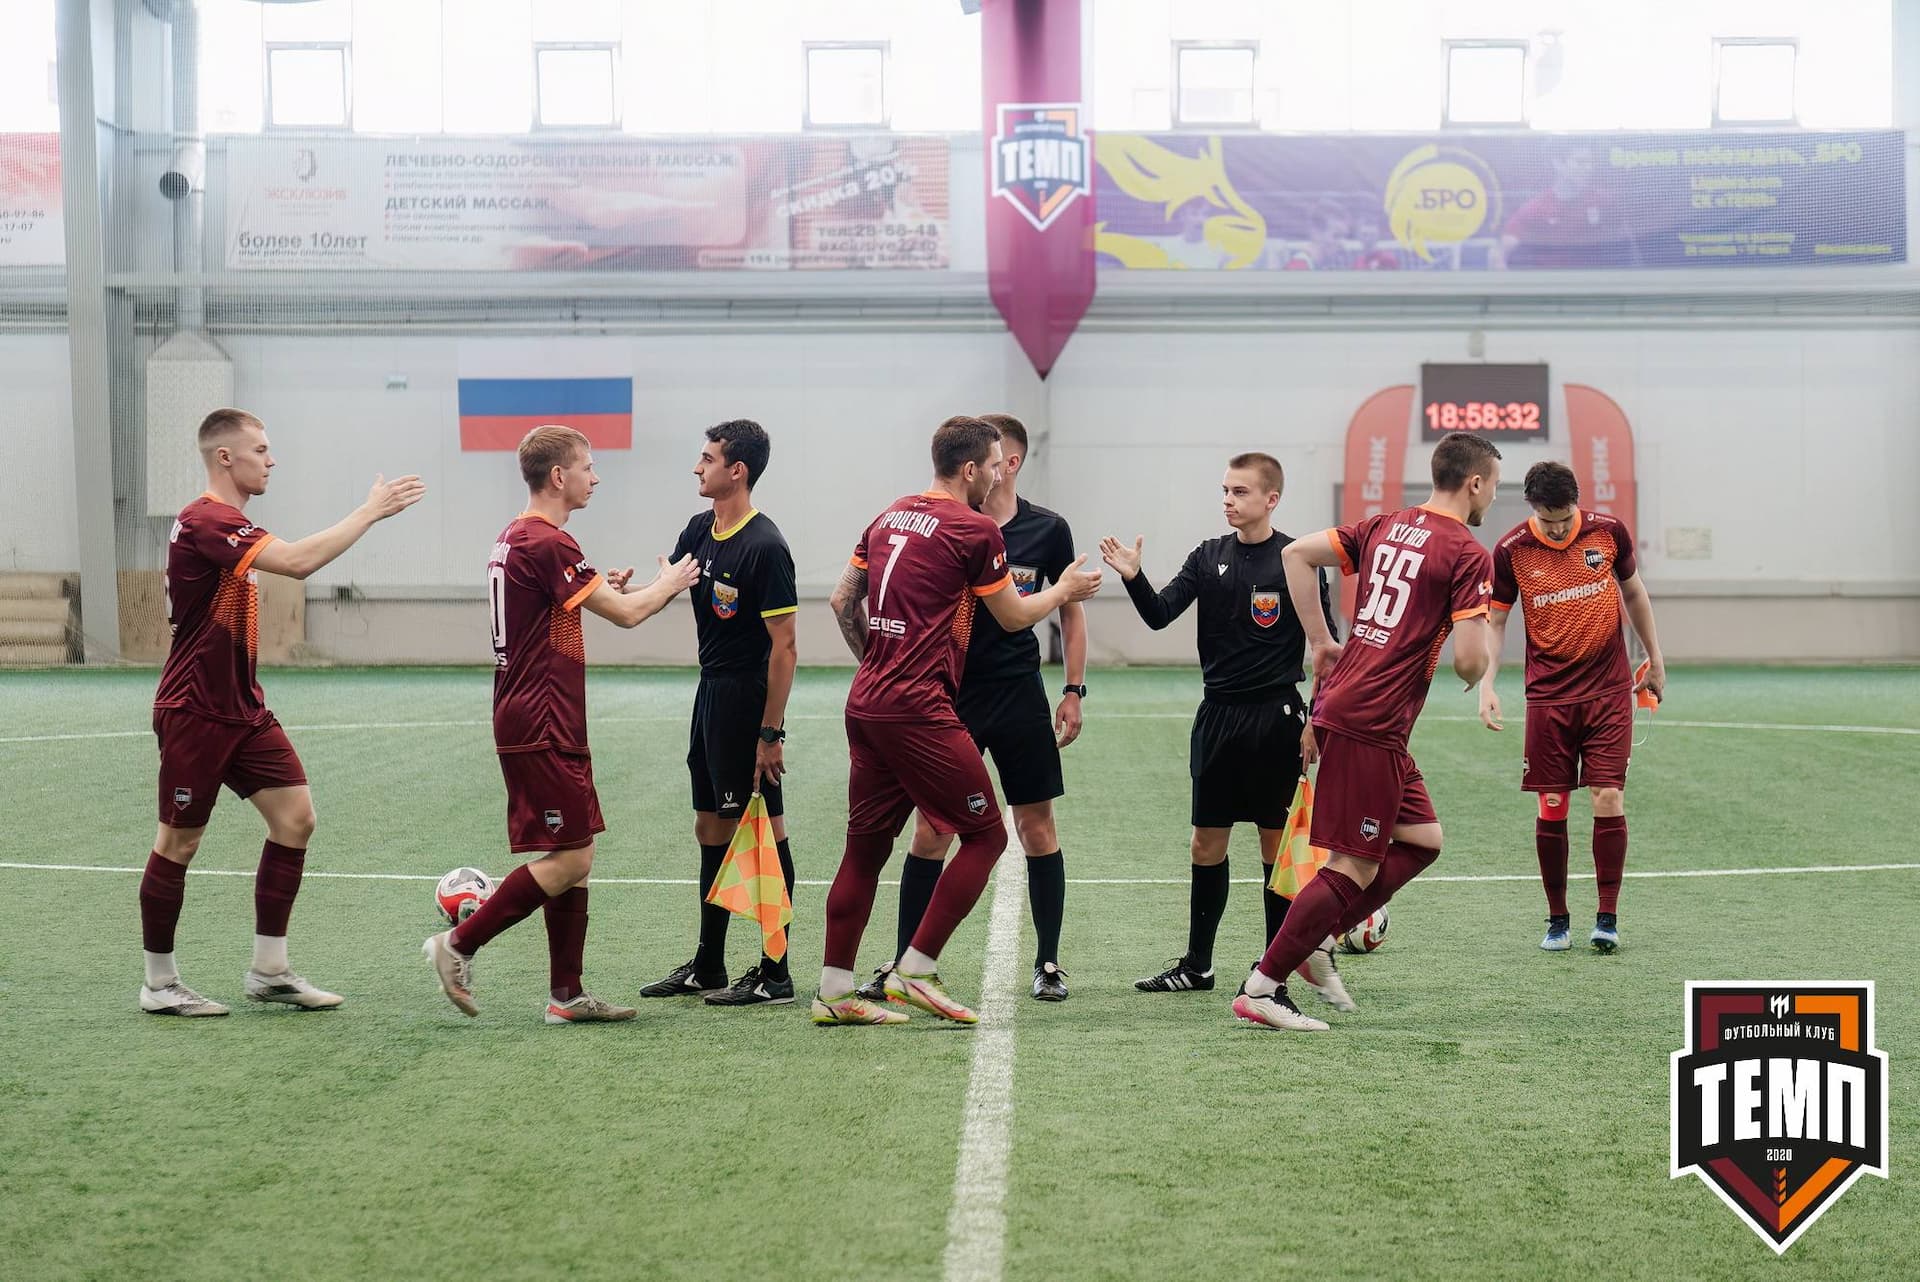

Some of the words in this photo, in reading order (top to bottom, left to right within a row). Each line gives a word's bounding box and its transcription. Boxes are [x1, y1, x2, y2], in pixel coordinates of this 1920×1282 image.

[1001, 139, 1082, 183] ТЕМП
[385, 194, 467, 211] ДЕТСКИЙ
[239, 231, 302, 249] более
[310, 231, 368, 249] 10лет
[1426, 402, 1540, 430] 18:58:32
[1362, 436, 1388, 501] Банк
[878, 533, 910, 611] 7
